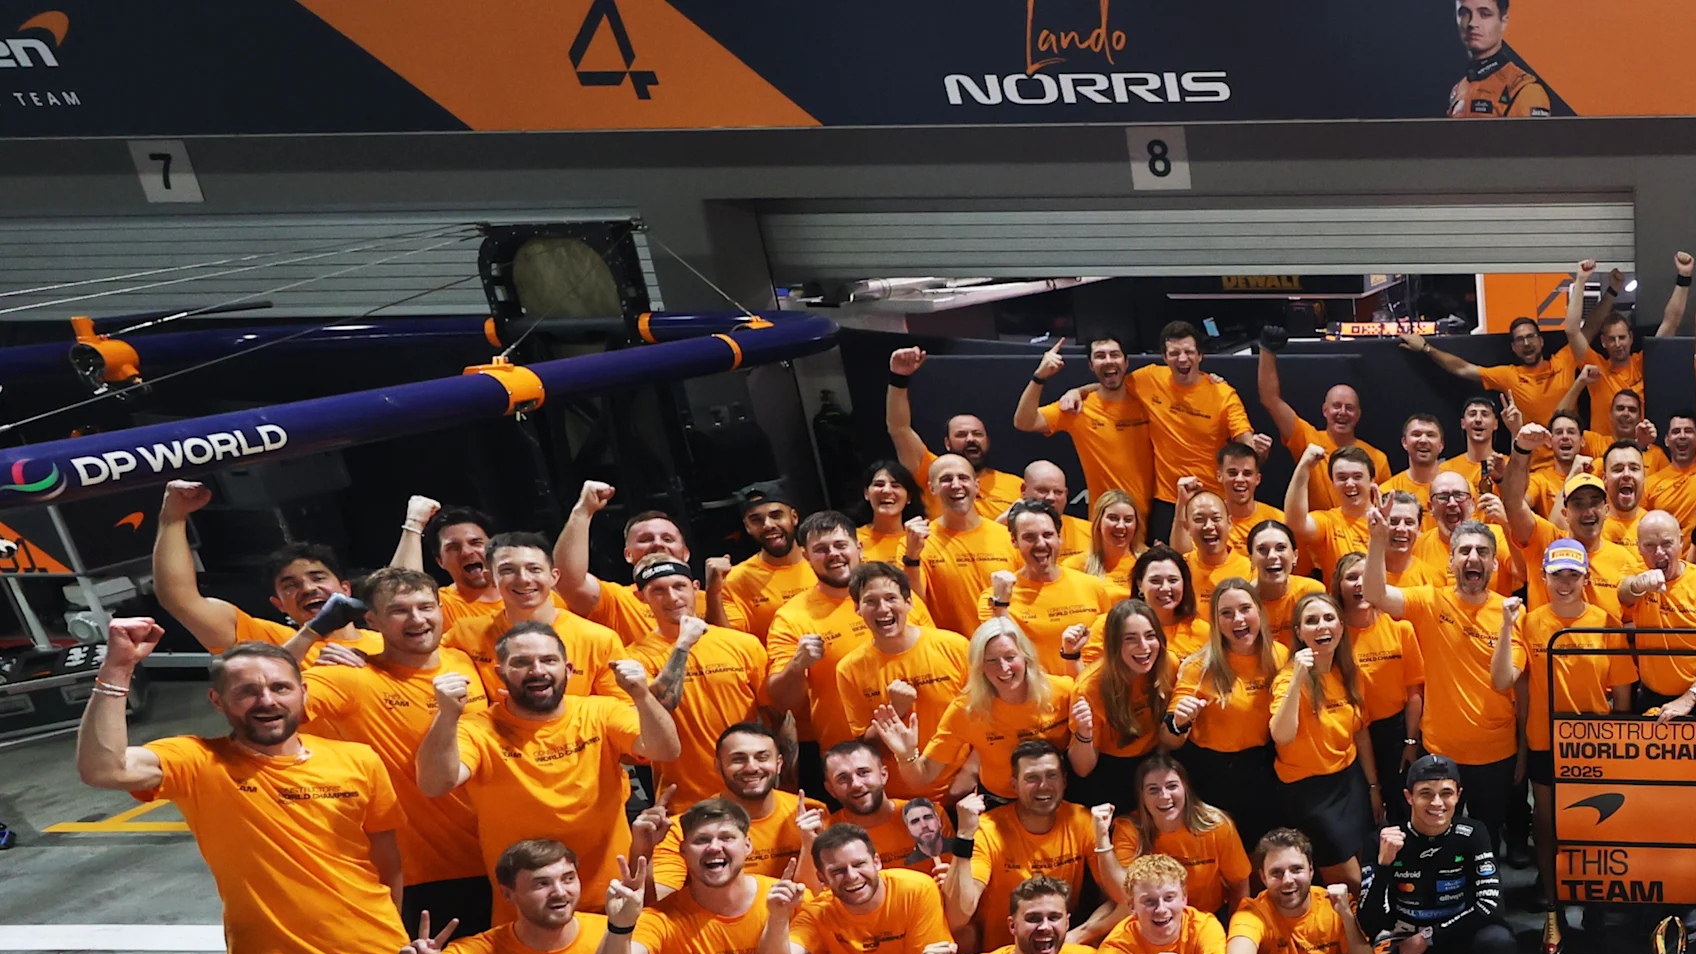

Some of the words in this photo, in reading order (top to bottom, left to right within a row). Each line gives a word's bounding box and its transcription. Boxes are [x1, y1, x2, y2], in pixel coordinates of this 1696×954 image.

[567, 0, 660, 100] 4
[1023, 0, 1128, 75] Lando
[13, 91, 82, 107] TEAM
[943, 70, 1232, 106] NORRIS
[147, 152, 175, 192] 7
[1146, 138, 1173, 179] 8
[70, 450, 139, 487] DP
[135, 423, 289, 474] WORLD
[1559, 742, 1640, 761] WORLD
[1559, 764, 1604, 779] 2025
[1394, 870, 1421, 879] Android
[1561, 847, 1629, 876] THIS
[1560, 879, 1664, 903] TEAM
